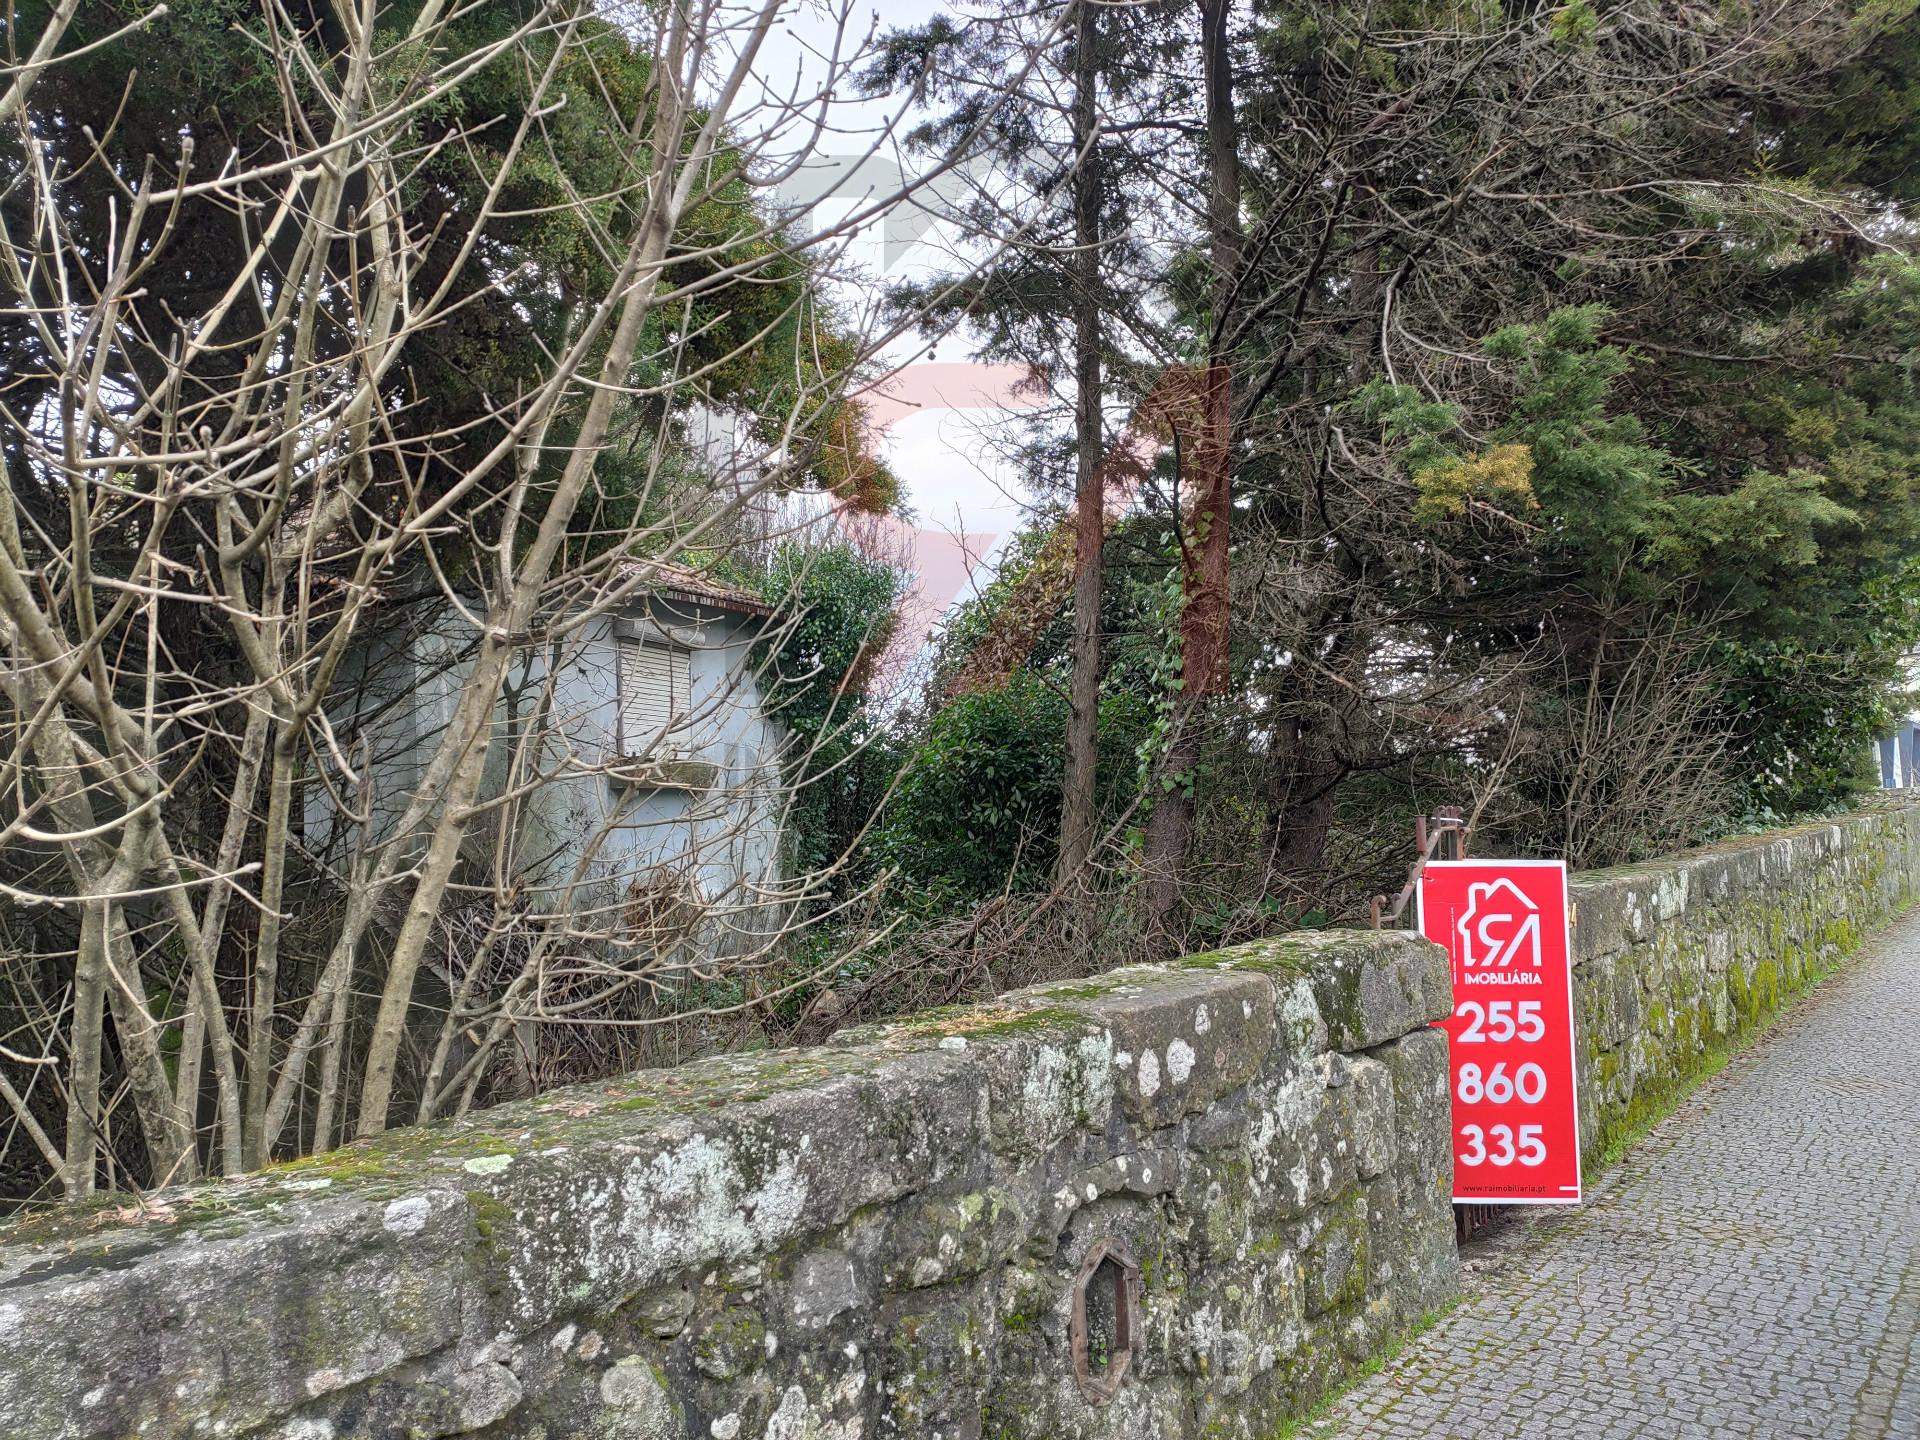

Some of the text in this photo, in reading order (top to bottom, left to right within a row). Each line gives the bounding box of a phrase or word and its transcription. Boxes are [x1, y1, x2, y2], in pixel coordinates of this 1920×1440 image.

[1464, 968, 1543, 985] IMOBILIÁRIA
[1456, 1001, 1546, 1043] 255
[1457, 1062, 1547, 1104] 860
[1459, 1124, 1547, 1166] 335
[1462, 1184, 1546, 1194] www.raimobiliaria.pt
